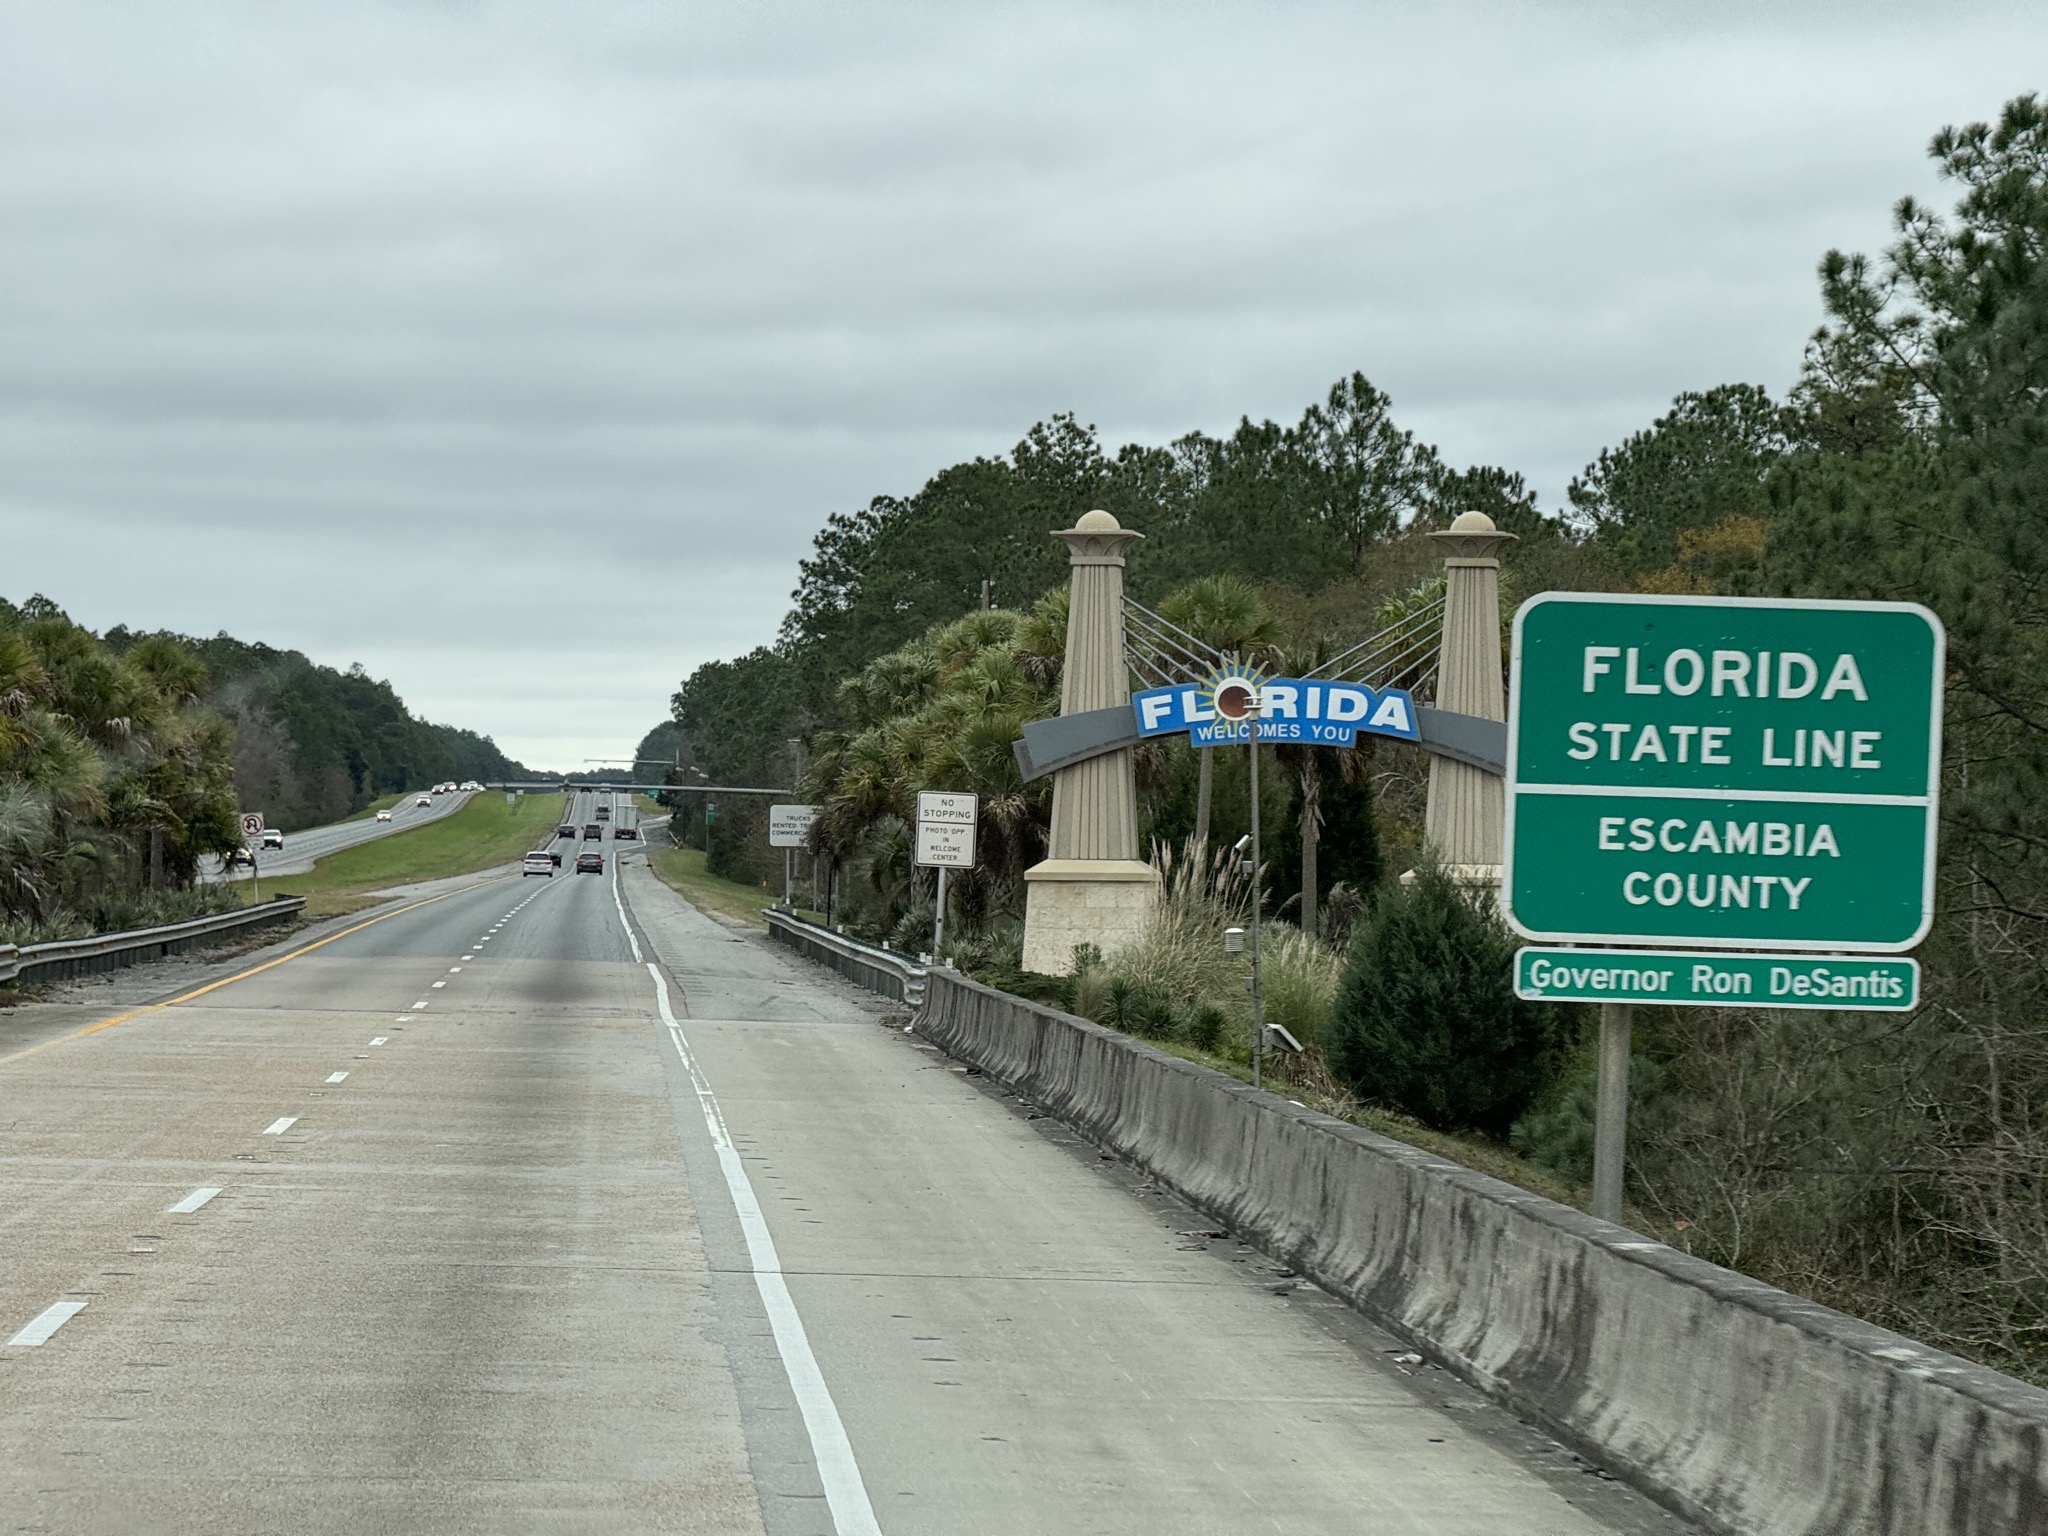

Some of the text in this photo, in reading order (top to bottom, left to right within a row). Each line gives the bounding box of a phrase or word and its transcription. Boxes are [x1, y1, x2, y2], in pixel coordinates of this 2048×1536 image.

[1583, 646, 1868, 701] FLORIDA
[1140, 677, 1411, 732] FLORIDA
[1312, 724, 1351, 742] YOU
[1567, 721, 1882, 769] STATE LINE
[923, 809, 971, 819] STOPPING
[941, 798, 955, 807] NO
[925, 826, 948, 834] PHOTO
[1598, 816, 1840, 858] ESCAMBIA
[1623, 871, 1812, 910] COUNTY
[1528, 959, 1904, 999] Governor Ron DeSantis
